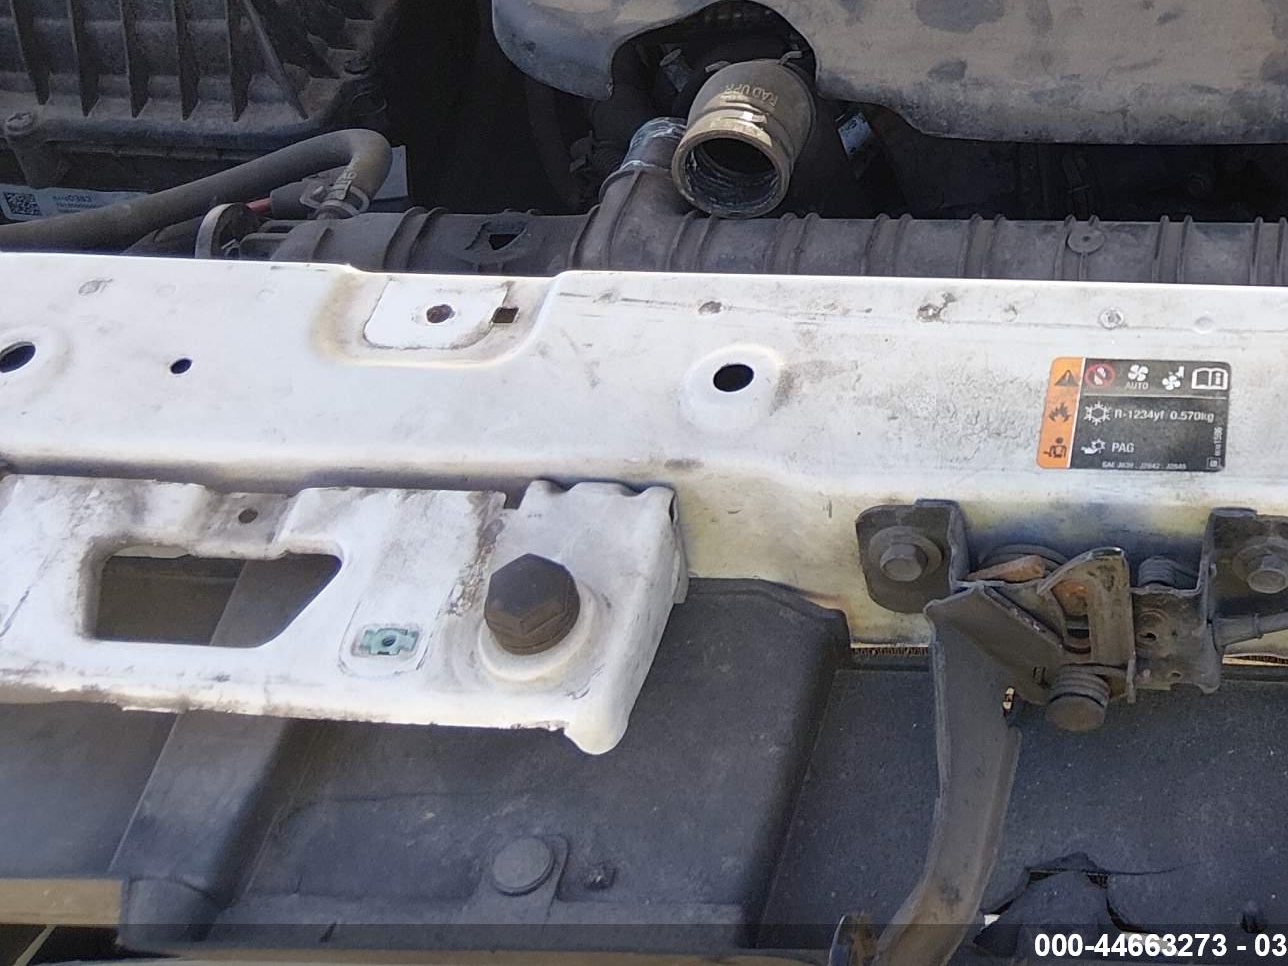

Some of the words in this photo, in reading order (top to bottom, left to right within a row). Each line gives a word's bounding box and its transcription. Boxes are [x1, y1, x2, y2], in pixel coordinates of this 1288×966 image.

[752, 85, 779, 107] RAD
[1125, 381, 1149, 390] AUTO
[1114, 409, 1165, 422] R-1234yf
[1170, 411, 1215, 423] 0.570kg
[1111, 442, 1135, 453] PAG
